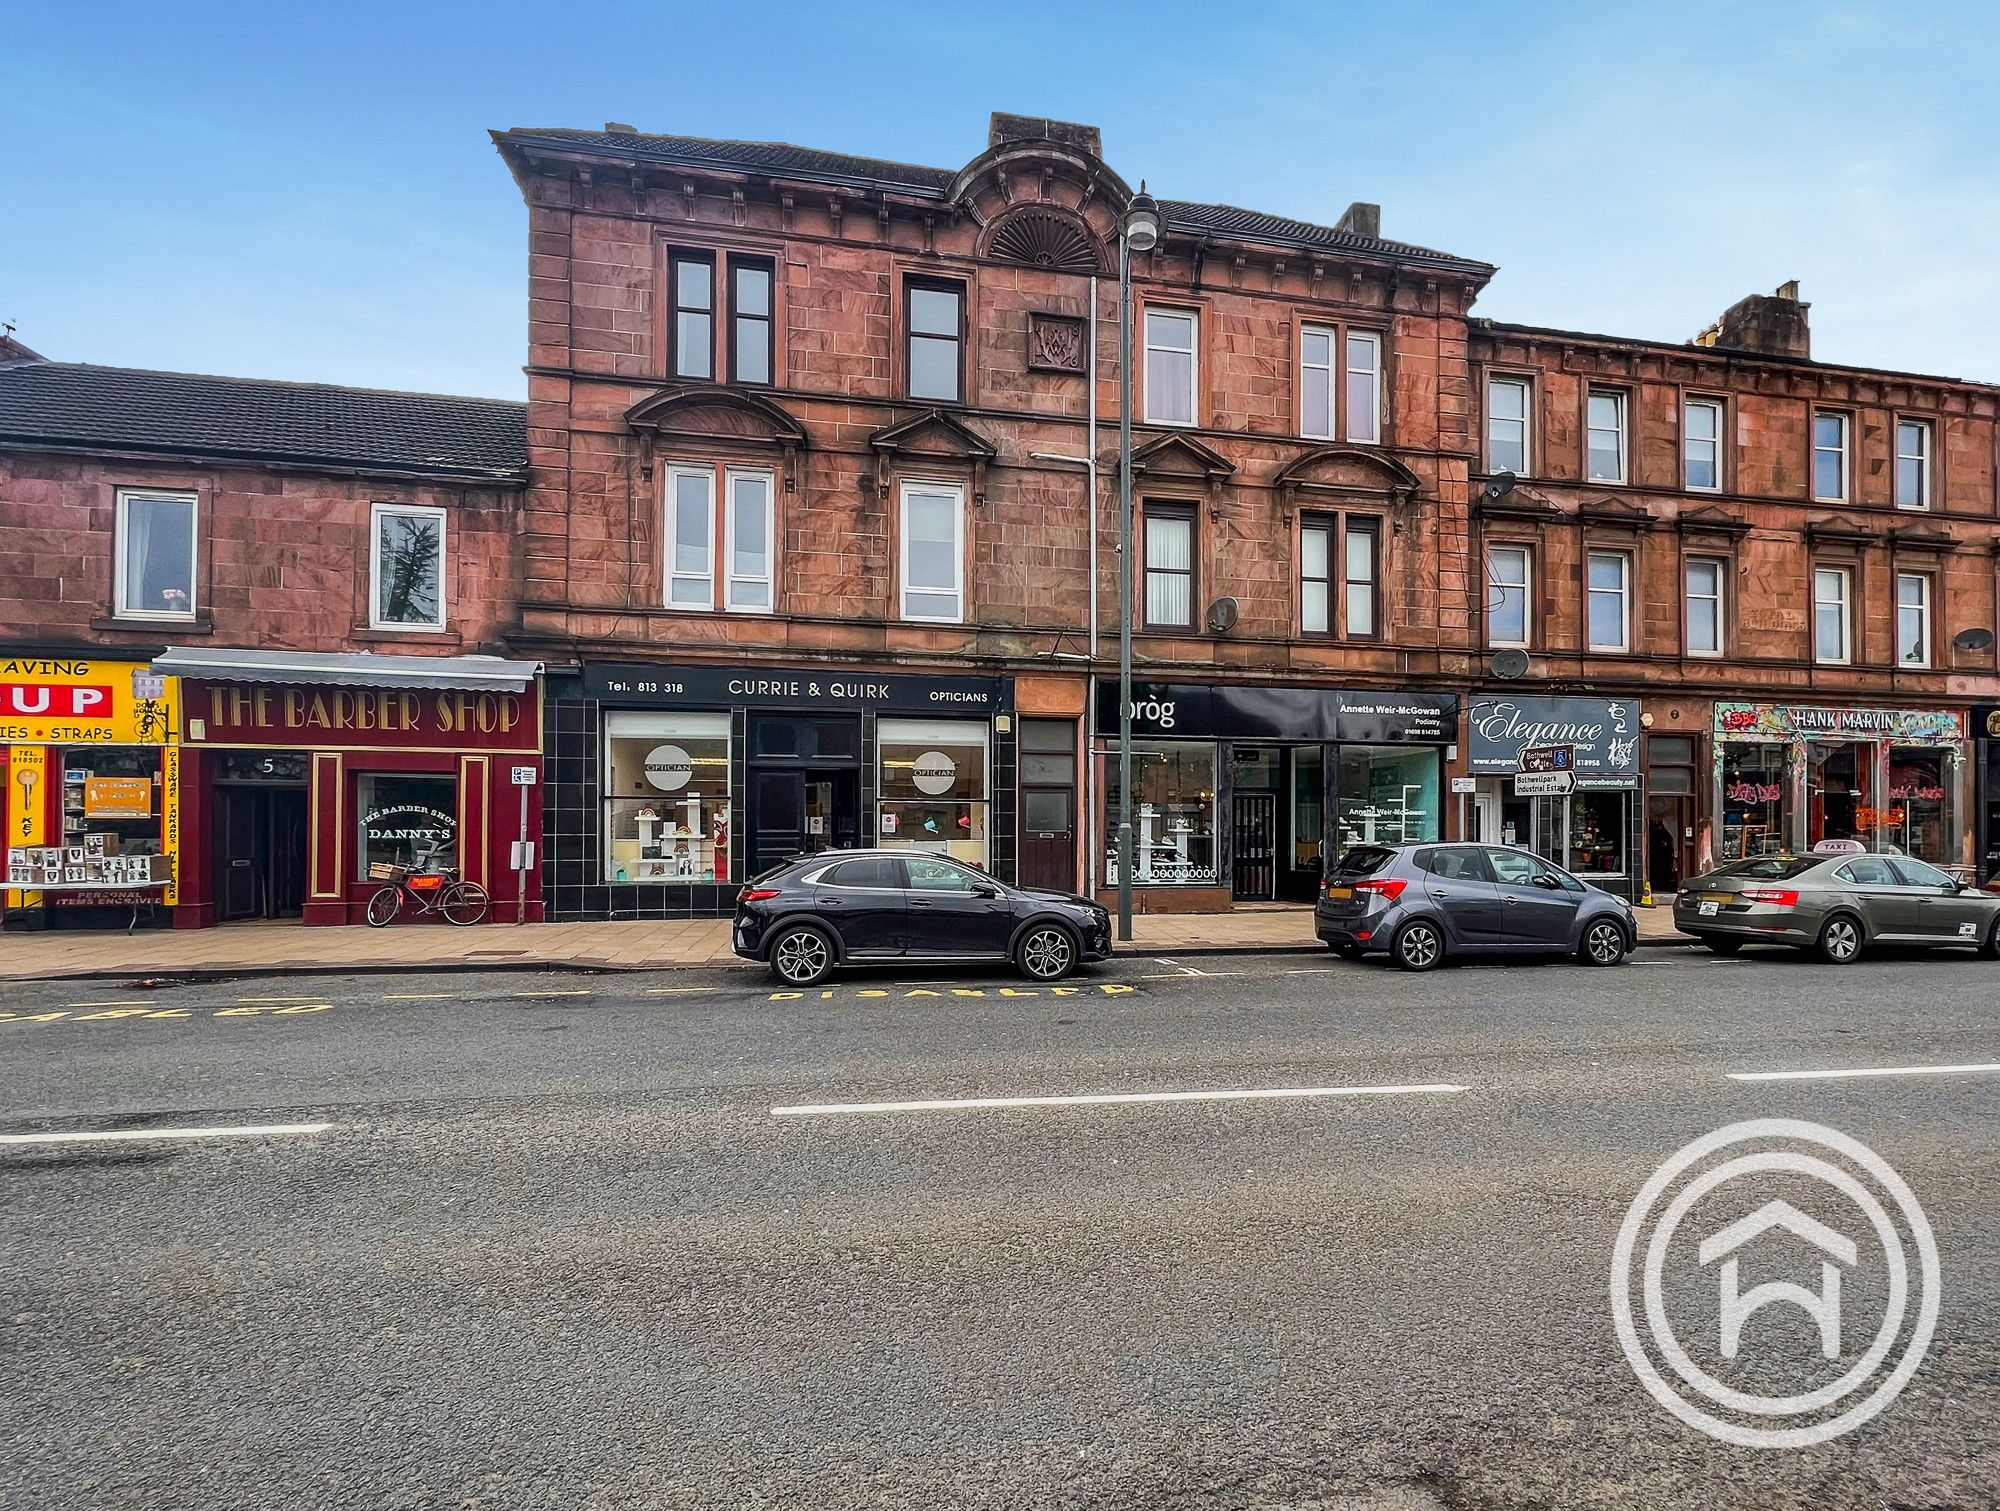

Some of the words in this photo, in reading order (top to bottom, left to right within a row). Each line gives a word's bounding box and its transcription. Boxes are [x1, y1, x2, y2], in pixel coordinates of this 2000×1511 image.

[0, 660, 89, 675] AVING
[638, 682, 658, 692] 813
[664, 683, 683, 693] 318
[728, 679, 799, 696] CURRIE
[808, 682, 822, 697] &
[830, 683, 890, 699] QUIRK
[12, 687, 103, 713] UP
[929, 691, 988, 702] OPTICIANS
[205, 686, 274, 727] THE
[284, 688, 421, 731] BARBER
[436, 692, 520, 733] SHOP
[1340, 705, 1374, 714] Annette
[1376, 705, 1441, 716] Weir-McGowan
[1731, 712, 1758, 725] BBQ
[1794, 710, 1837, 727] HANK
[1842, 712, 1894, 729] MARVIN
[50, 727, 113, 739] STRAPS
[1470, 701, 1603, 757] Elegance
[1526, 750, 1553, 760] Bothwell
[262, 758, 274, 773] 5
[646, 764, 692, 772] OPTICIAN
[914, 769, 955, 777] OPTICIAN
[1516, 783, 1545, 792] Industrial
[359, 811, 381, 827] THE
[382, 804, 429, 816] BARBER
[21, 817, 32, 837] KEY
[168, 803, 177, 844] TANKARDS
